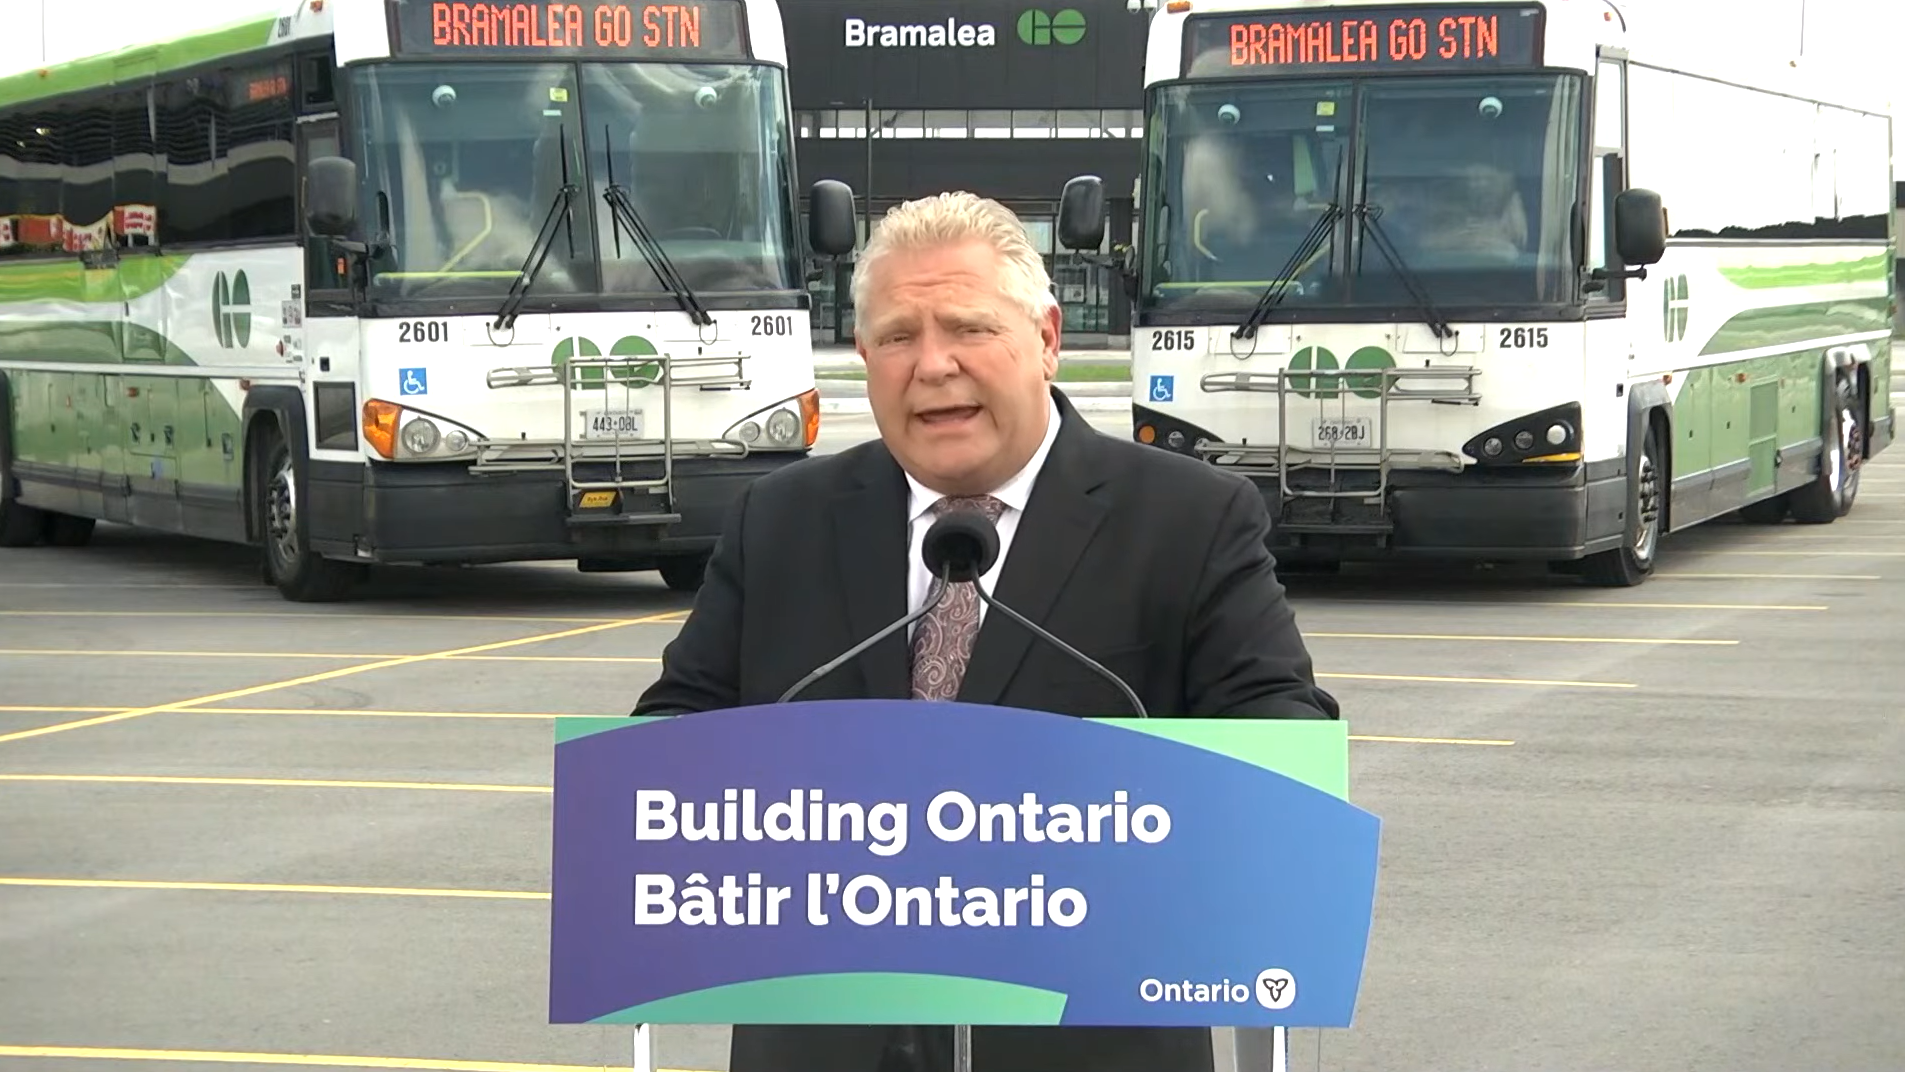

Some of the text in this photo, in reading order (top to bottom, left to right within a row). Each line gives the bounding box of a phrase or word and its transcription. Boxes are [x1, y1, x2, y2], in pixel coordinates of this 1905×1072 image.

[433, 2, 699, 48] BRAMALEA GO STN
[845, 17, 995, 47] Bramalea
[1230, 15, 1497, 65] BRAMALEA GO STN
[399, 321, 448, 342] 2601
[751, 315, 792, 336] 2601
[1500, 327, 1548, 348] 2615
[1152, 330, 1195, 351] 2615
[635, 788, 1171, 857] Building Ontario
[634, 872, 791, 926] Bâtir
[1140, 978, 1250, 1003] Ontario
